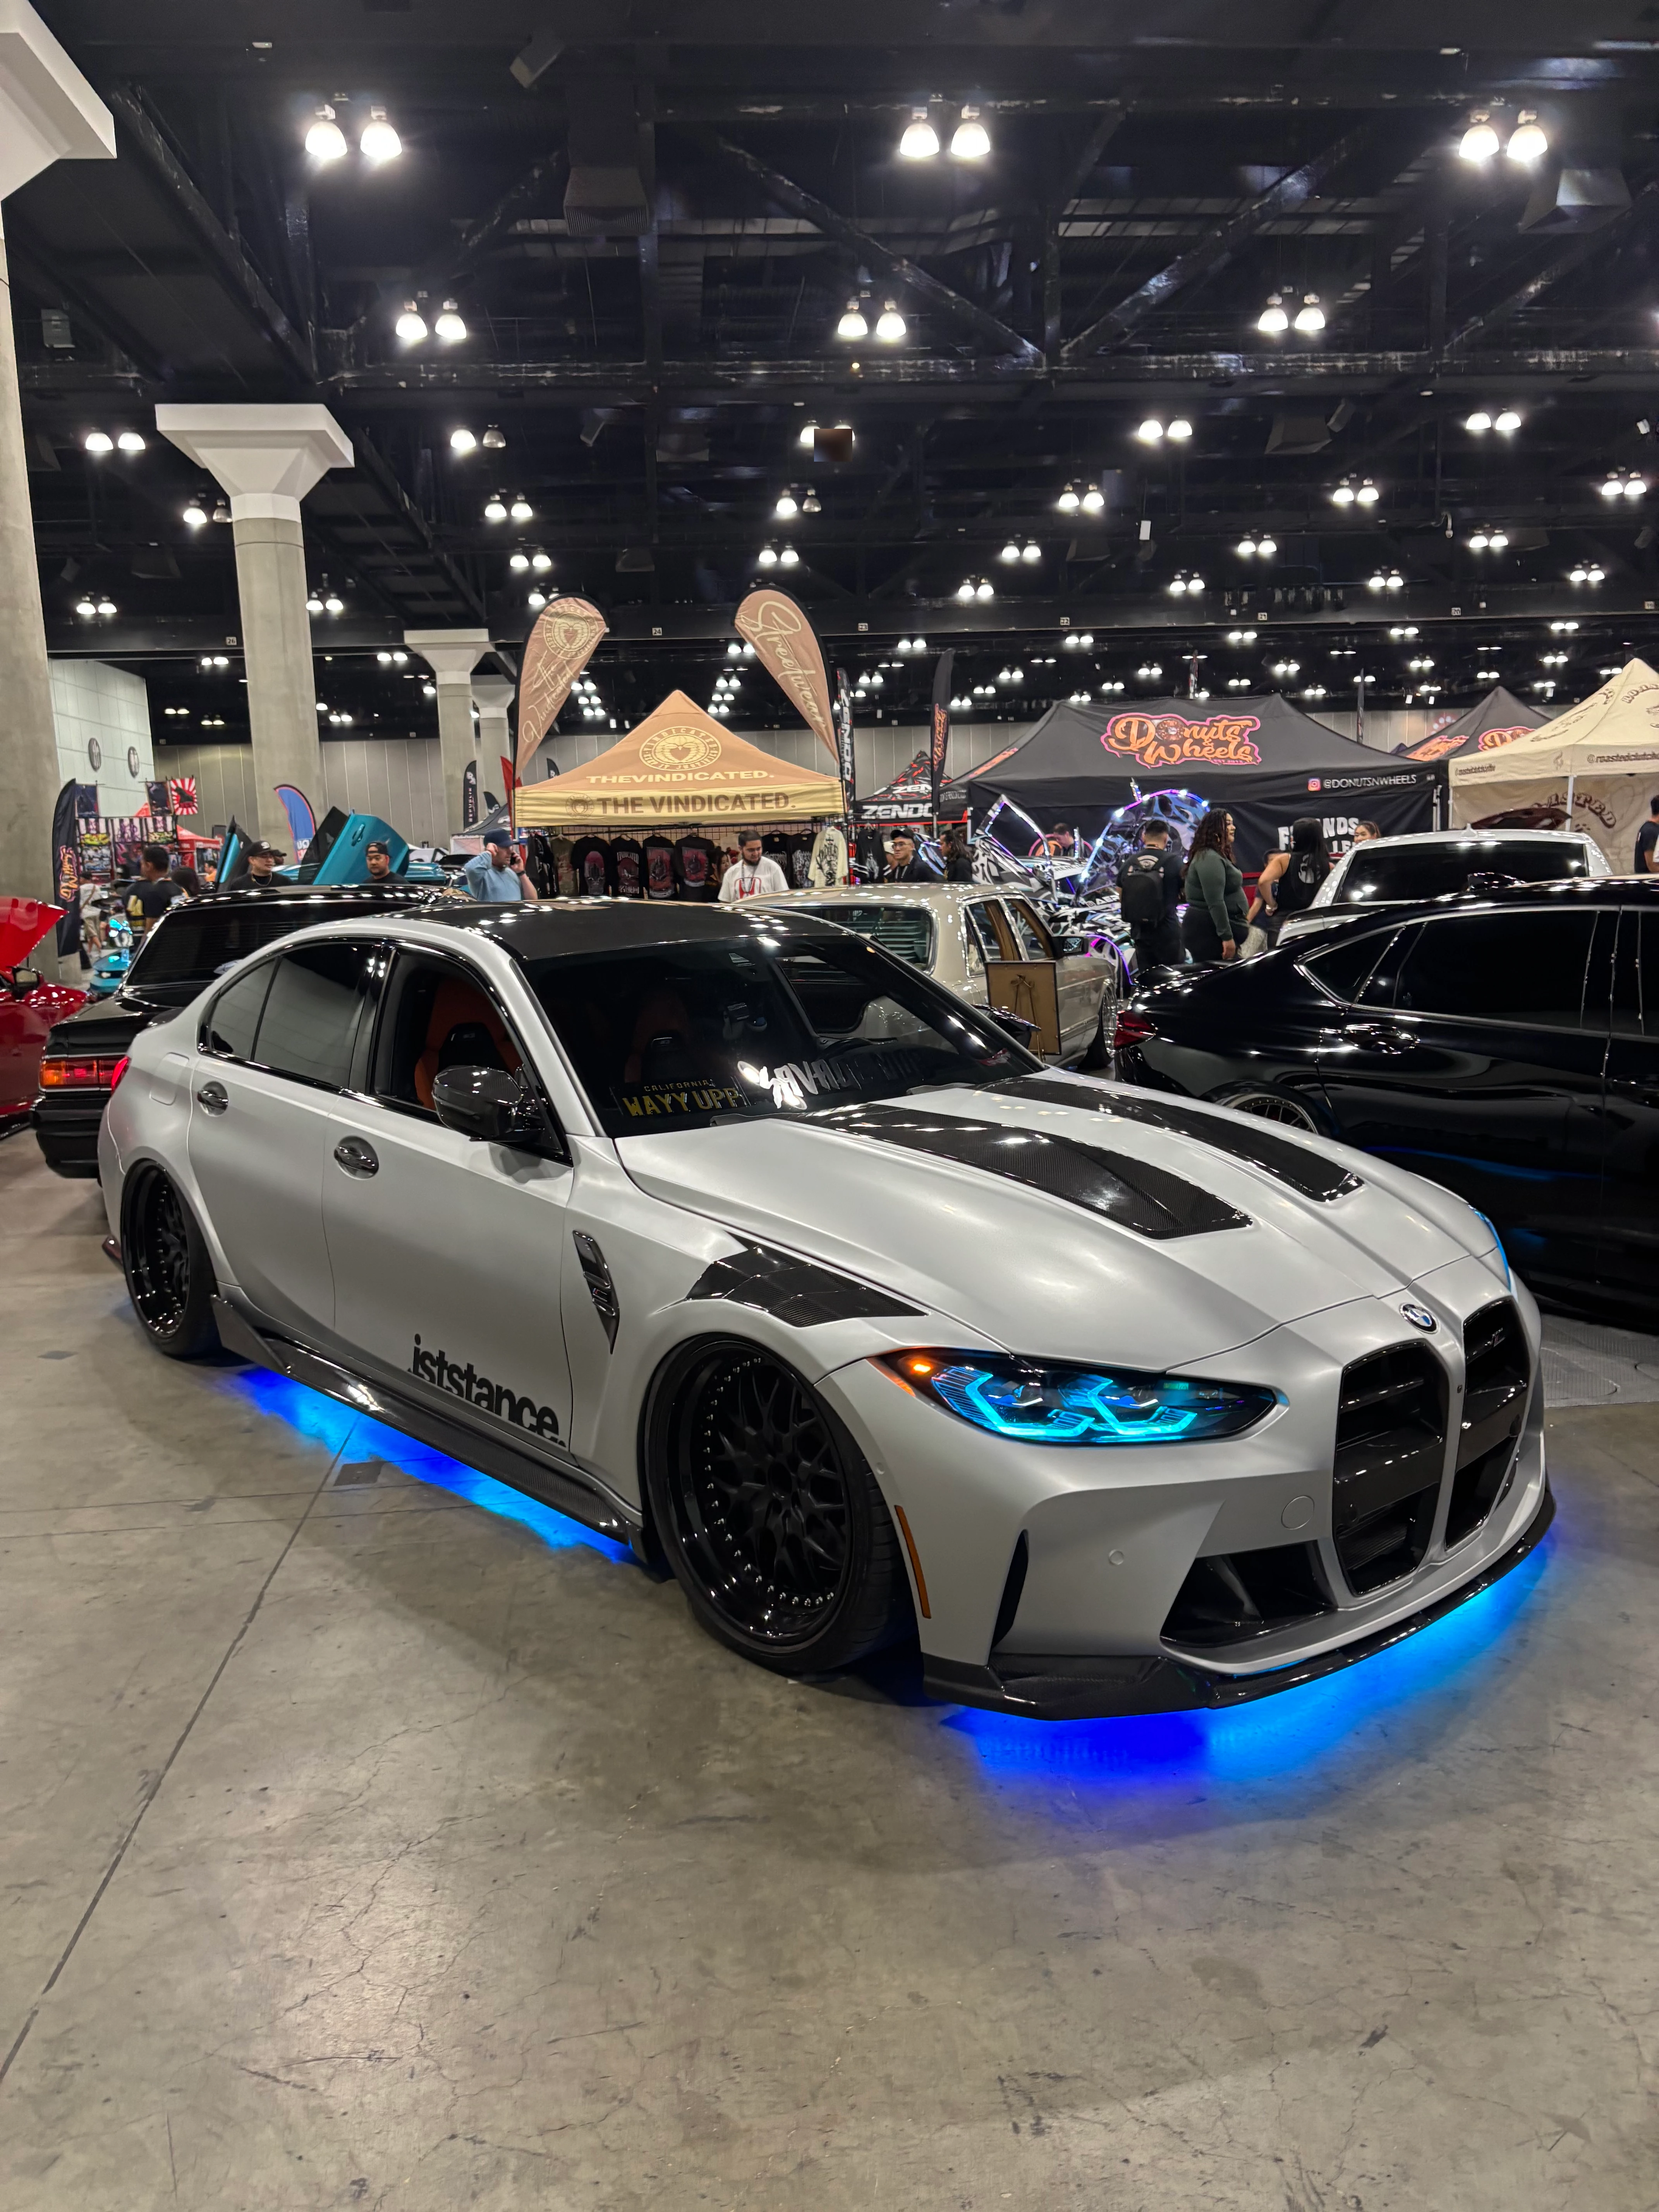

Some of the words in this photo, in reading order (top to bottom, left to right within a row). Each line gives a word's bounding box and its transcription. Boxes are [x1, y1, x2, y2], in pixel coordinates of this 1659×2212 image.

[1143, 738, 1253, 764] Wheels
[892, 783, 932, 794] ZEN
[596, 797, 644, 814] THE
[649, 792, 796, 814] VINDICATED.
[1278, 817, 1359, 851] FNDS
[644, 1079, 709, 1092] CALIFORNIA
[622, 1091, 688, 1116] WAYY
[691, 1088, 739, 1109] UPP
